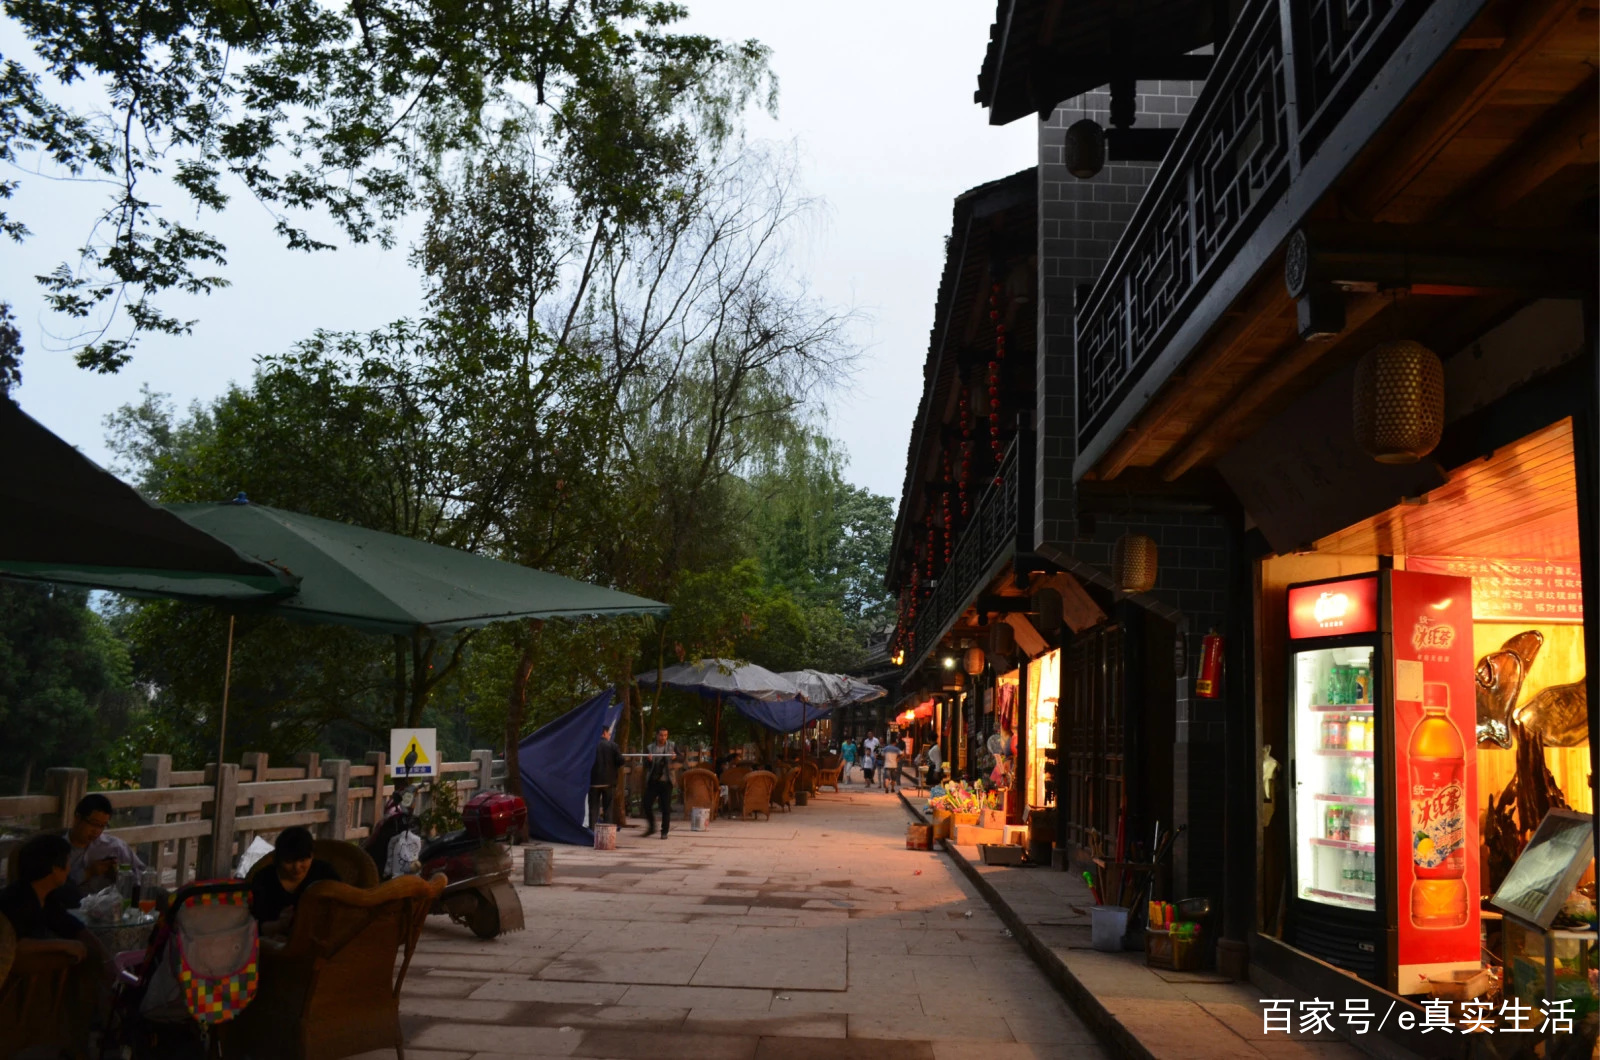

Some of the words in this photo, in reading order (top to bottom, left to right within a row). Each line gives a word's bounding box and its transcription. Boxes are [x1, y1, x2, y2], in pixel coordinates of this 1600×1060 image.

[1419, 616, 1435, 624] 统一
[1413, 625, 1453, 650] 冰红茶
[1413, 785, 1434, 795] 统一
[1417, 786, 1461, 830] 冰红茶
